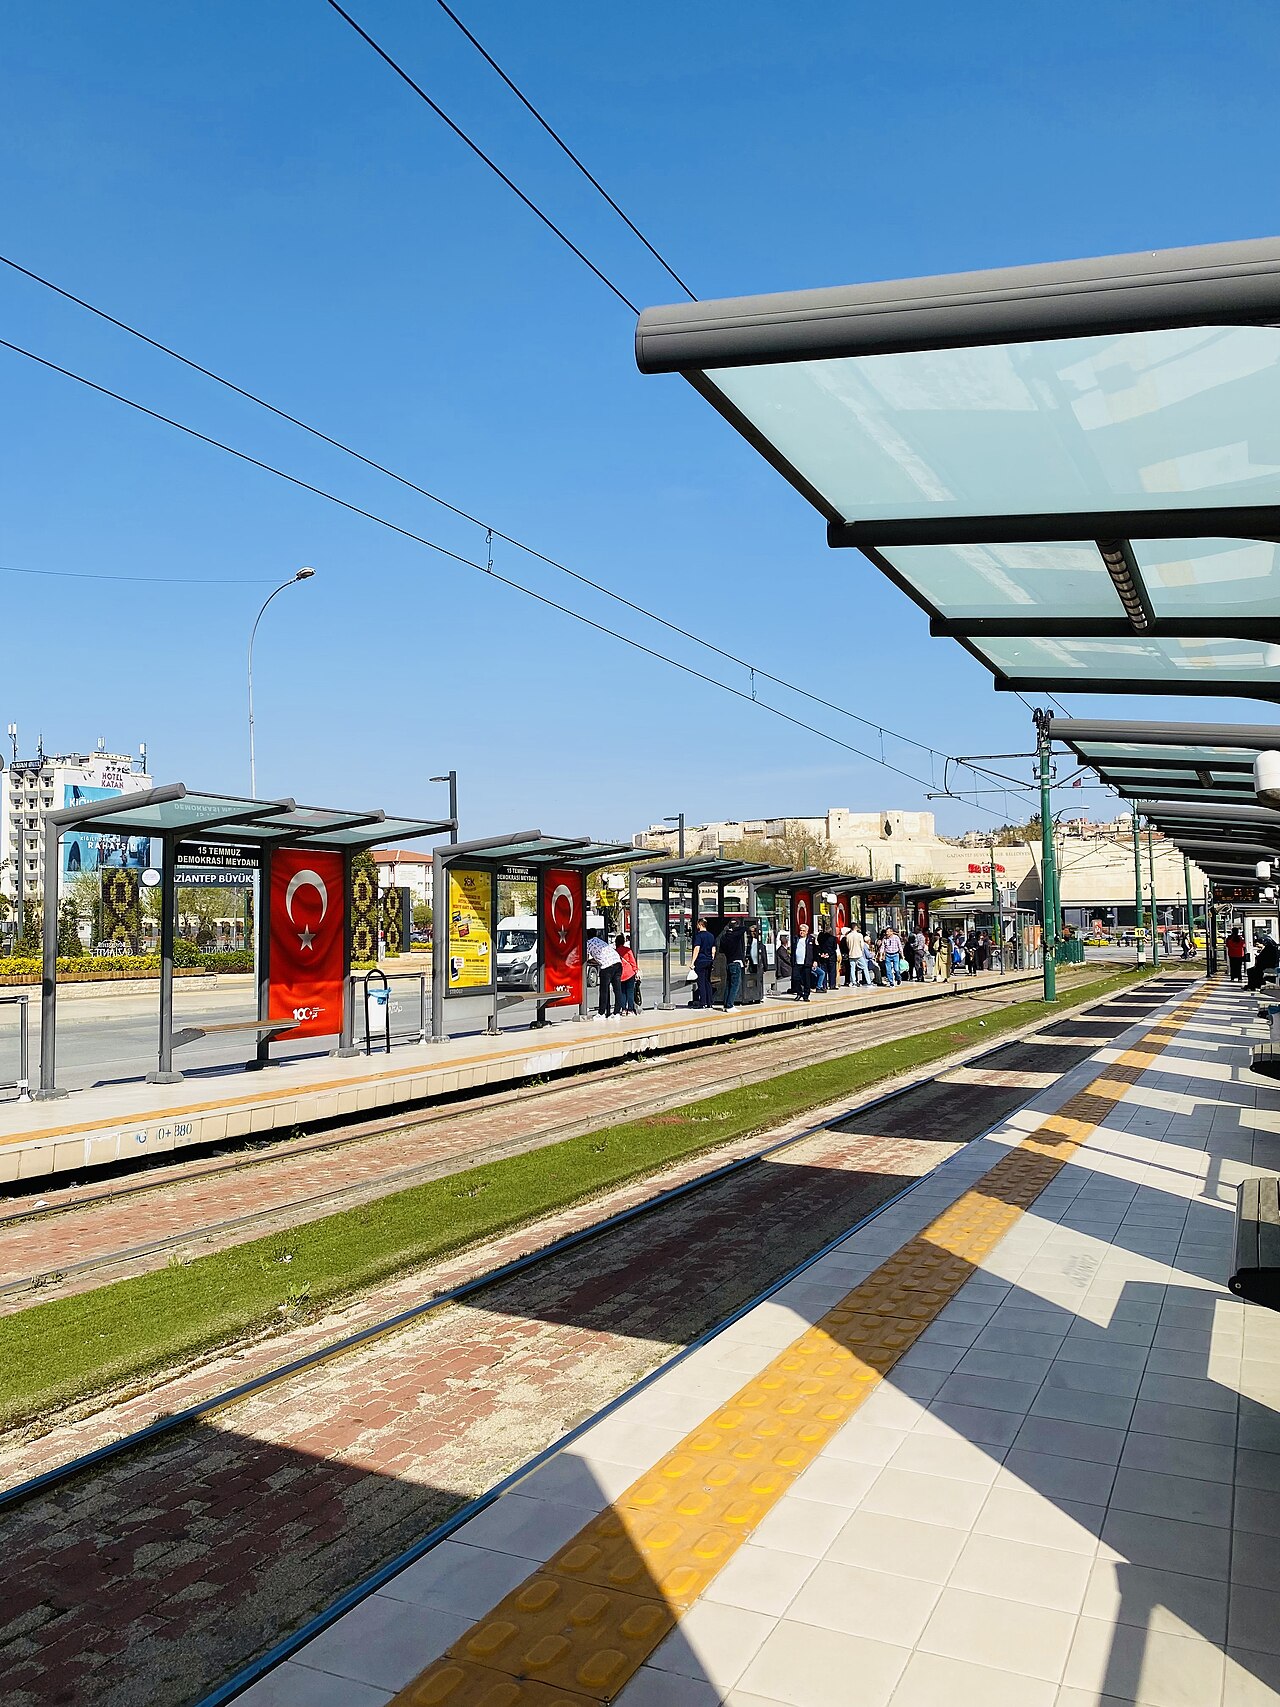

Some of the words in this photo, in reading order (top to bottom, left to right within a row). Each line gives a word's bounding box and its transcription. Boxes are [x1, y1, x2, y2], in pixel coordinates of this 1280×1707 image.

[102, 772, 123, 781] HOTEL
[209, 848, 241, 856] TEMMUZ
[178, 856, 224, 865] DEMOKRASİ
[225, 858, 259, 866] MEYDANI
